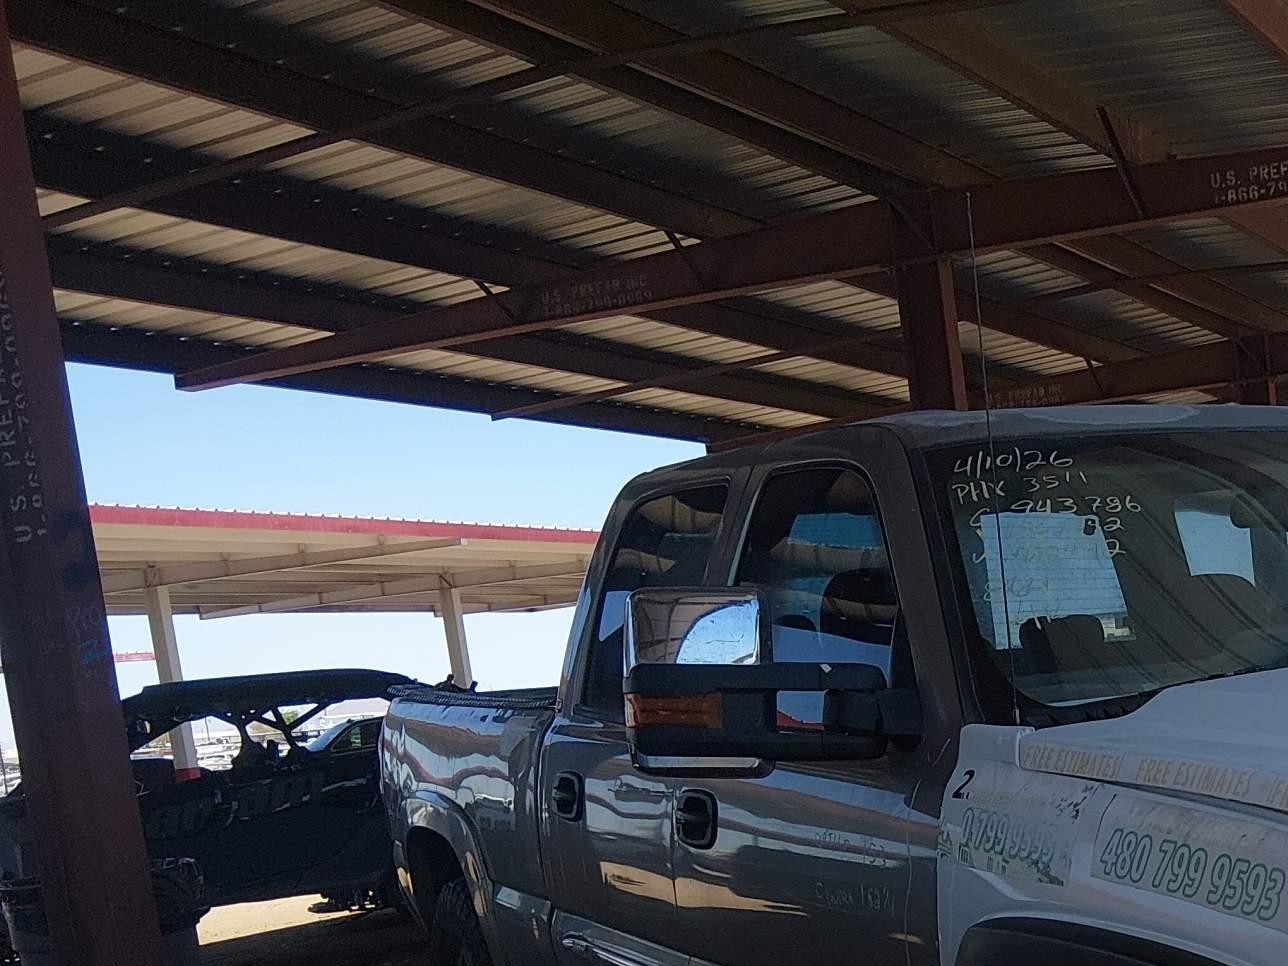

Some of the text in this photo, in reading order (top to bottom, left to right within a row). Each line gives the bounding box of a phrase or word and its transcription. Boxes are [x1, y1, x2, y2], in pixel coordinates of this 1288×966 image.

[1136, 758, 1254, 797] FREE ESTIMATES
[1100, 828, 1286, 921] 480 799 9593
